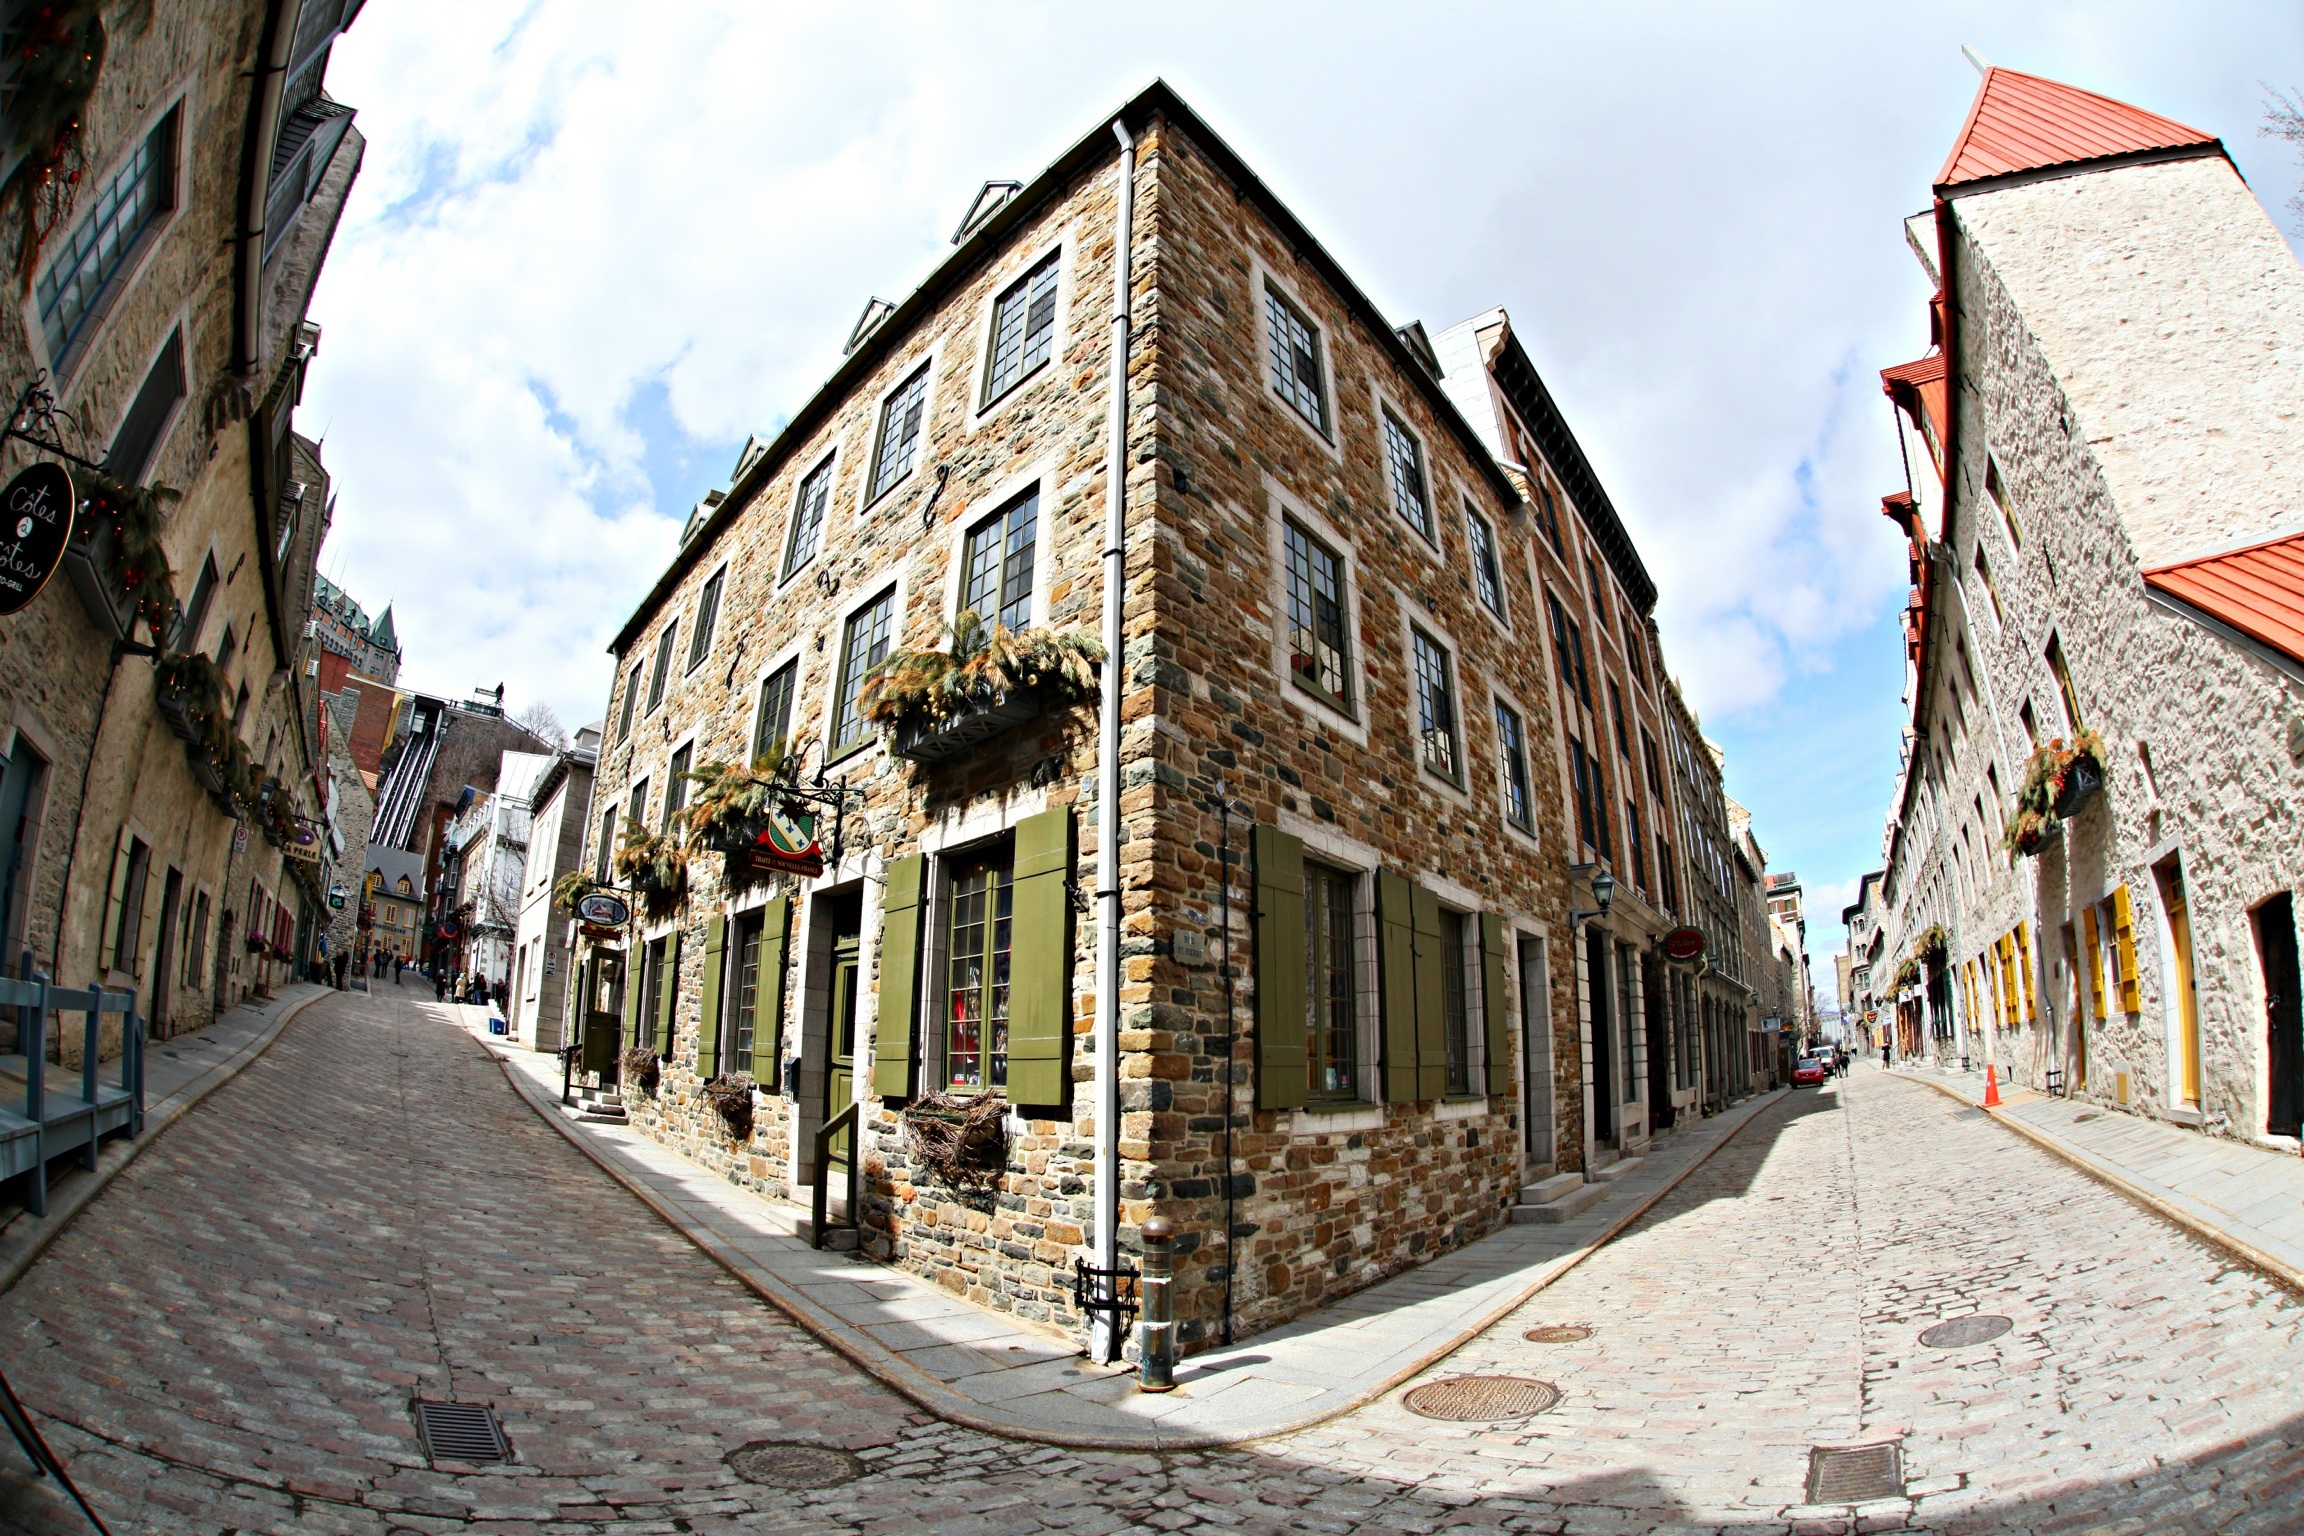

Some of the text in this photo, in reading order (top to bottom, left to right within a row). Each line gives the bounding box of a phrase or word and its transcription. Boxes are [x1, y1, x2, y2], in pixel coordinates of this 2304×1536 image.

[10, 485, 57, 525] Côtes
[0, 541, 42, 579] ôtes
[293, 846, 317, 859] PERLE
